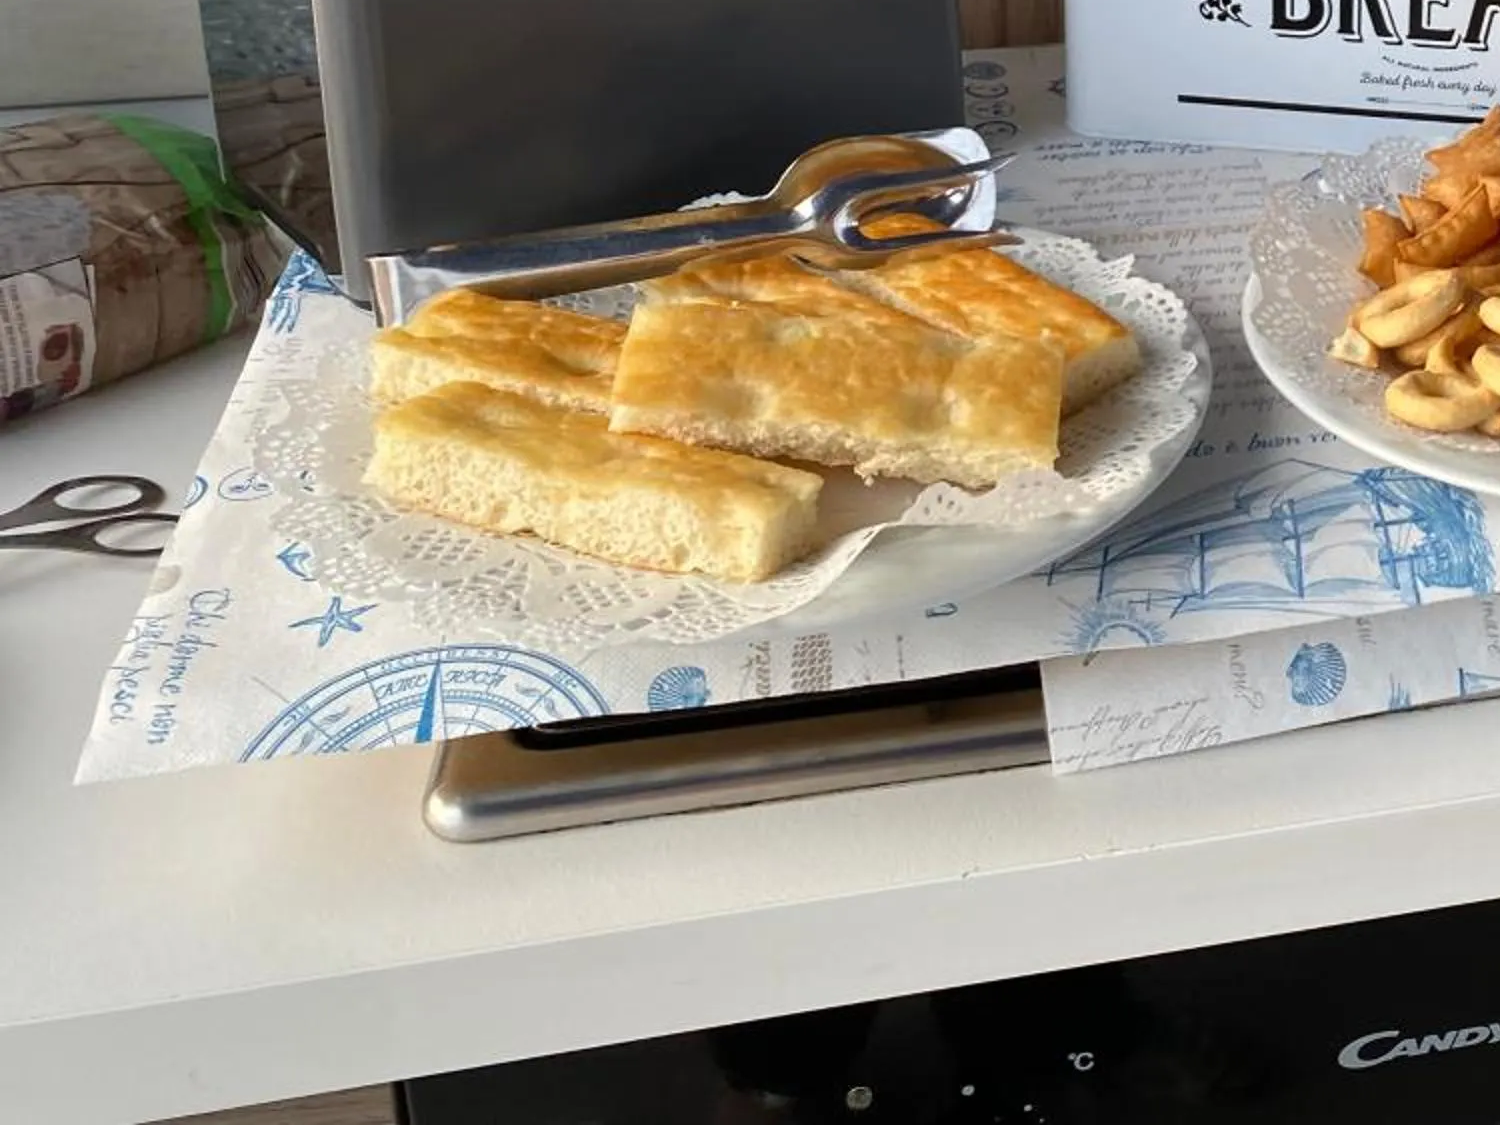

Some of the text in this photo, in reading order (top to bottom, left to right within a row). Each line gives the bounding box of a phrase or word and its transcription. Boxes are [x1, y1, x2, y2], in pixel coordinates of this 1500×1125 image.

[1360, 72, 1401, 87] Baked
[1401, 74, 1435, 92] fresh
[1473, 80, 1498, 98] day
[159, 633, 219, 697] dorme
[106, 664, 152, 724] pesci
[147, 704, 176, 744] non
